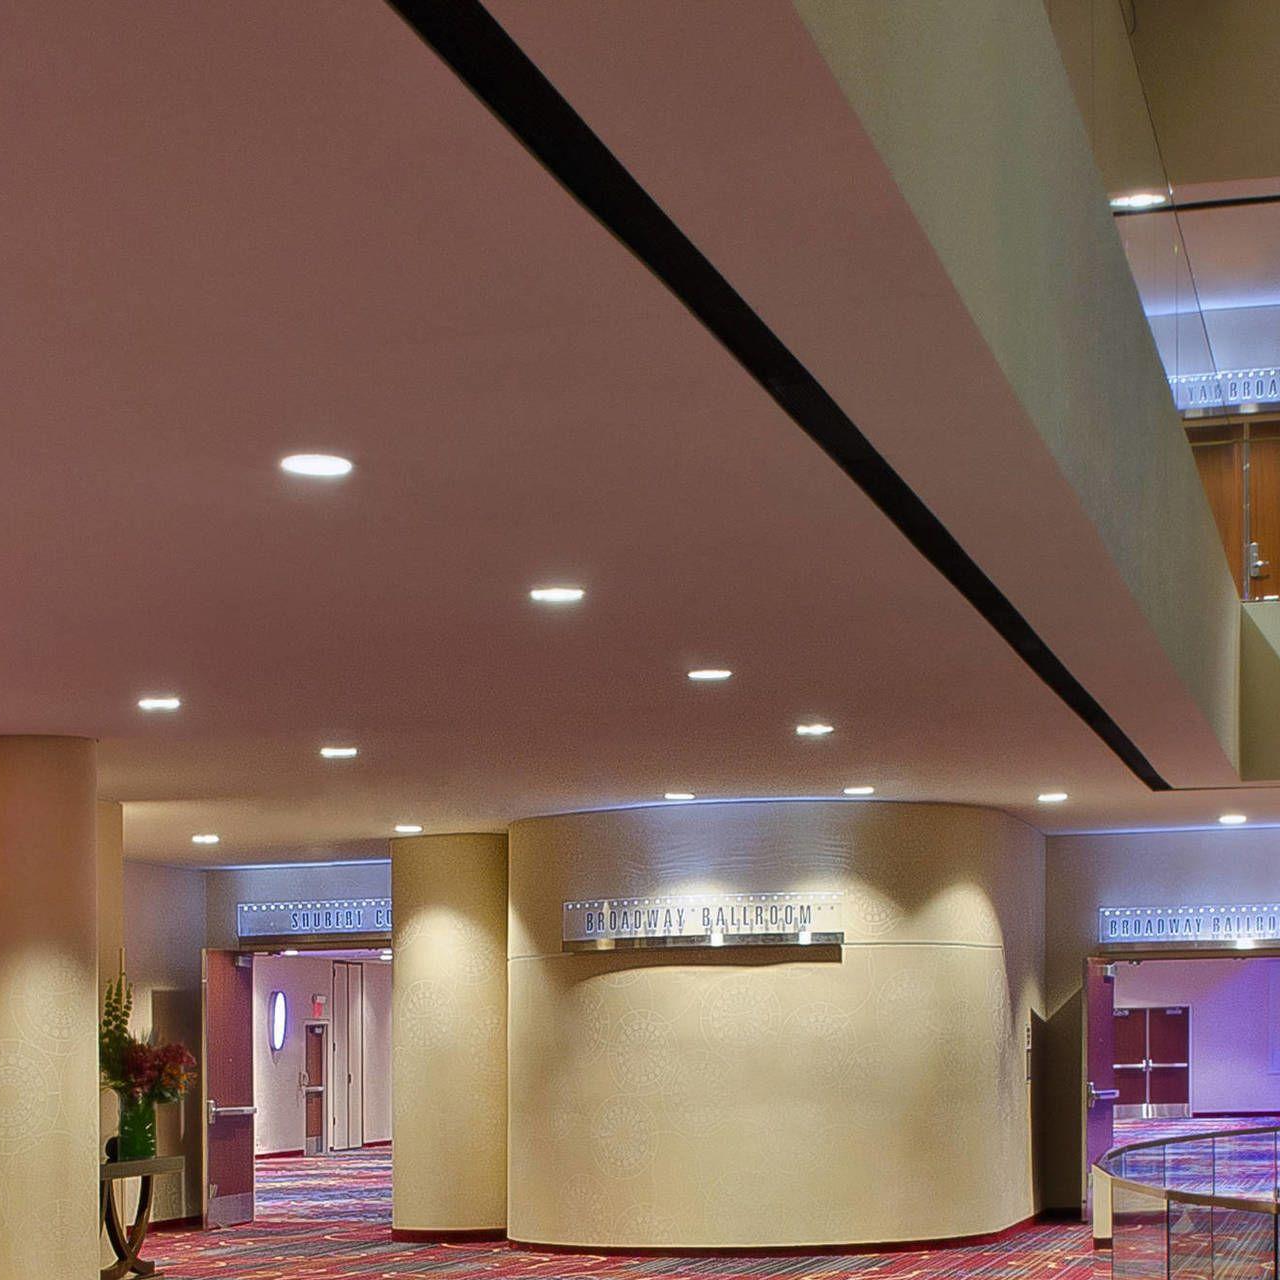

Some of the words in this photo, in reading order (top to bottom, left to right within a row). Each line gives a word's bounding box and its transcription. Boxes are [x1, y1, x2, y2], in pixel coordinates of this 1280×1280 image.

[291, 910, 362, 929] SHUBERT
[586, 908, 685, 932] BROADWAY
[702, 905, 812, 928] BALLROOM
[1109, 915, 1203, 937] BROADWAY
